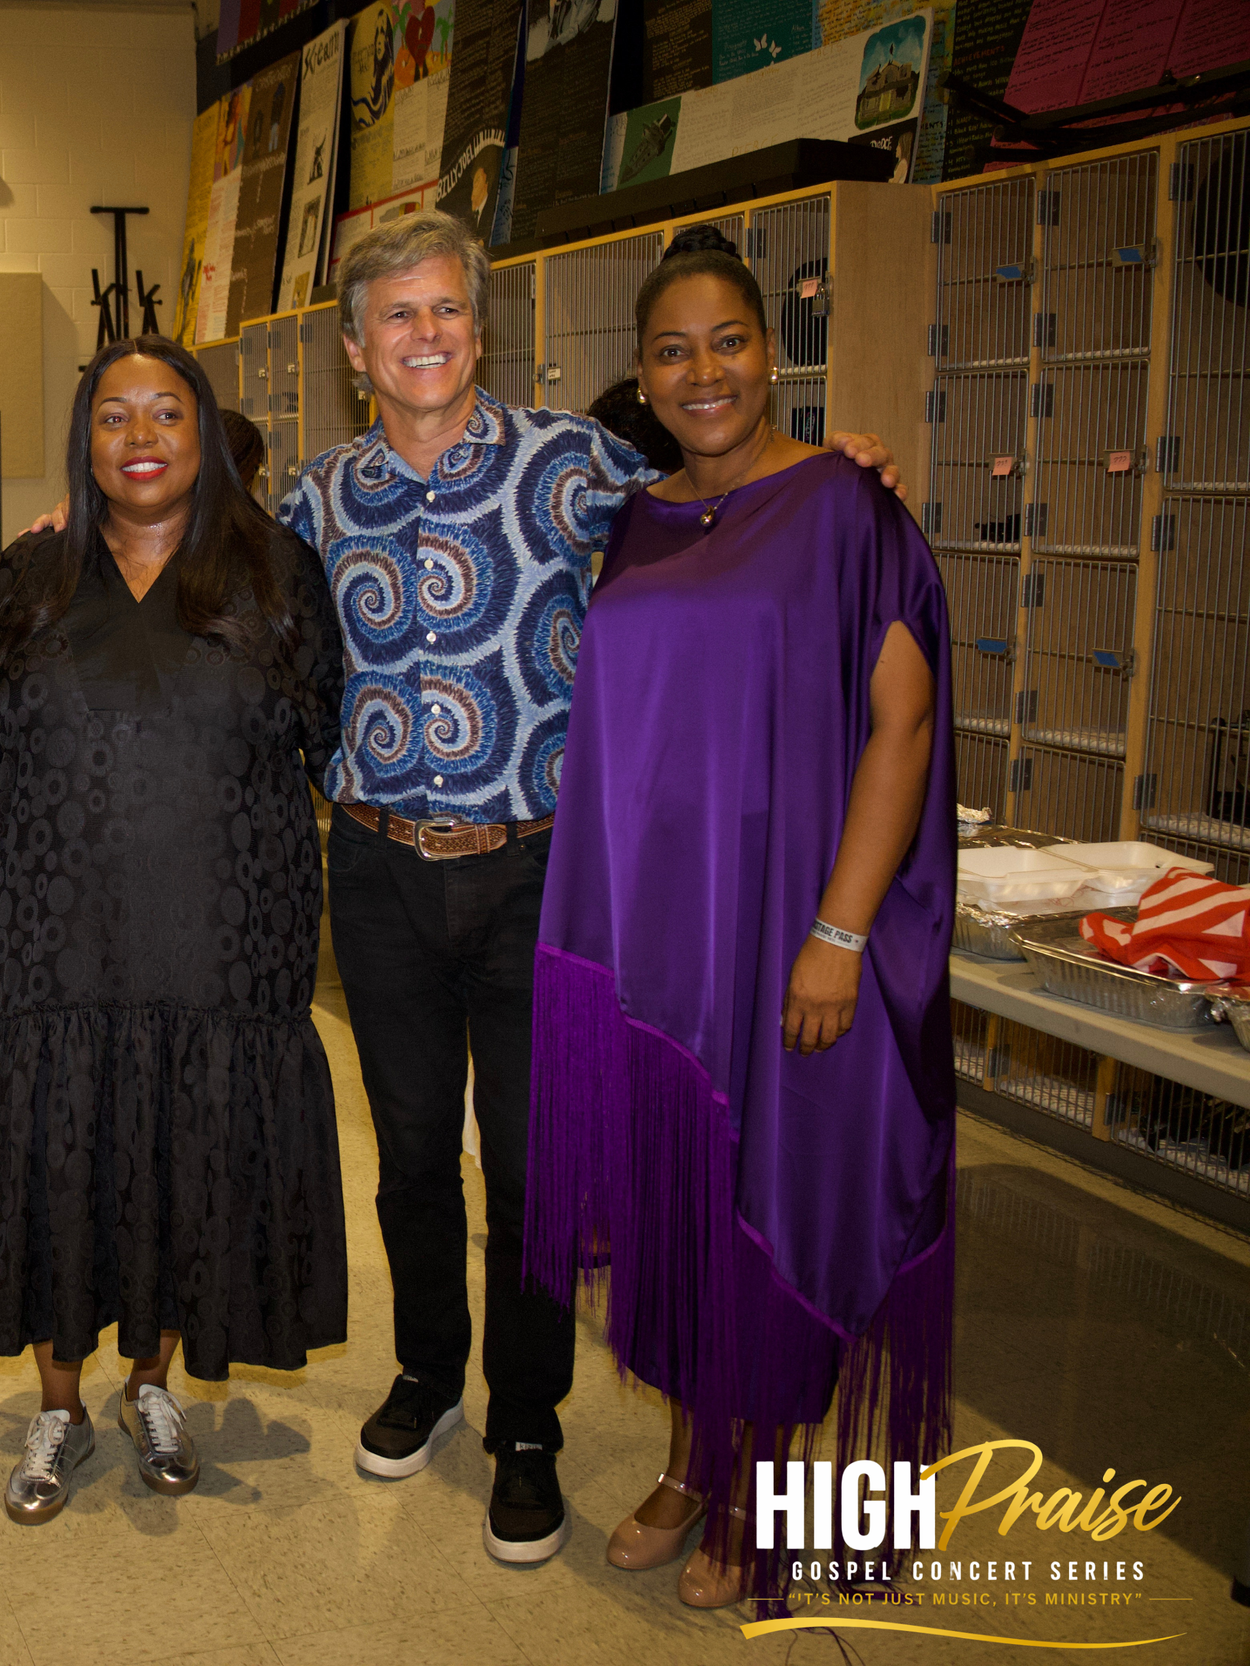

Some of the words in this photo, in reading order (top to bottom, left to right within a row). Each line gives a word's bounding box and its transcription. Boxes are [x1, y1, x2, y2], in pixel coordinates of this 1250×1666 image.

[436, 163, 458, 203] BILLY
[458, 142, 475, 178] JOEL
[834, 930, 853, 943] PASS
